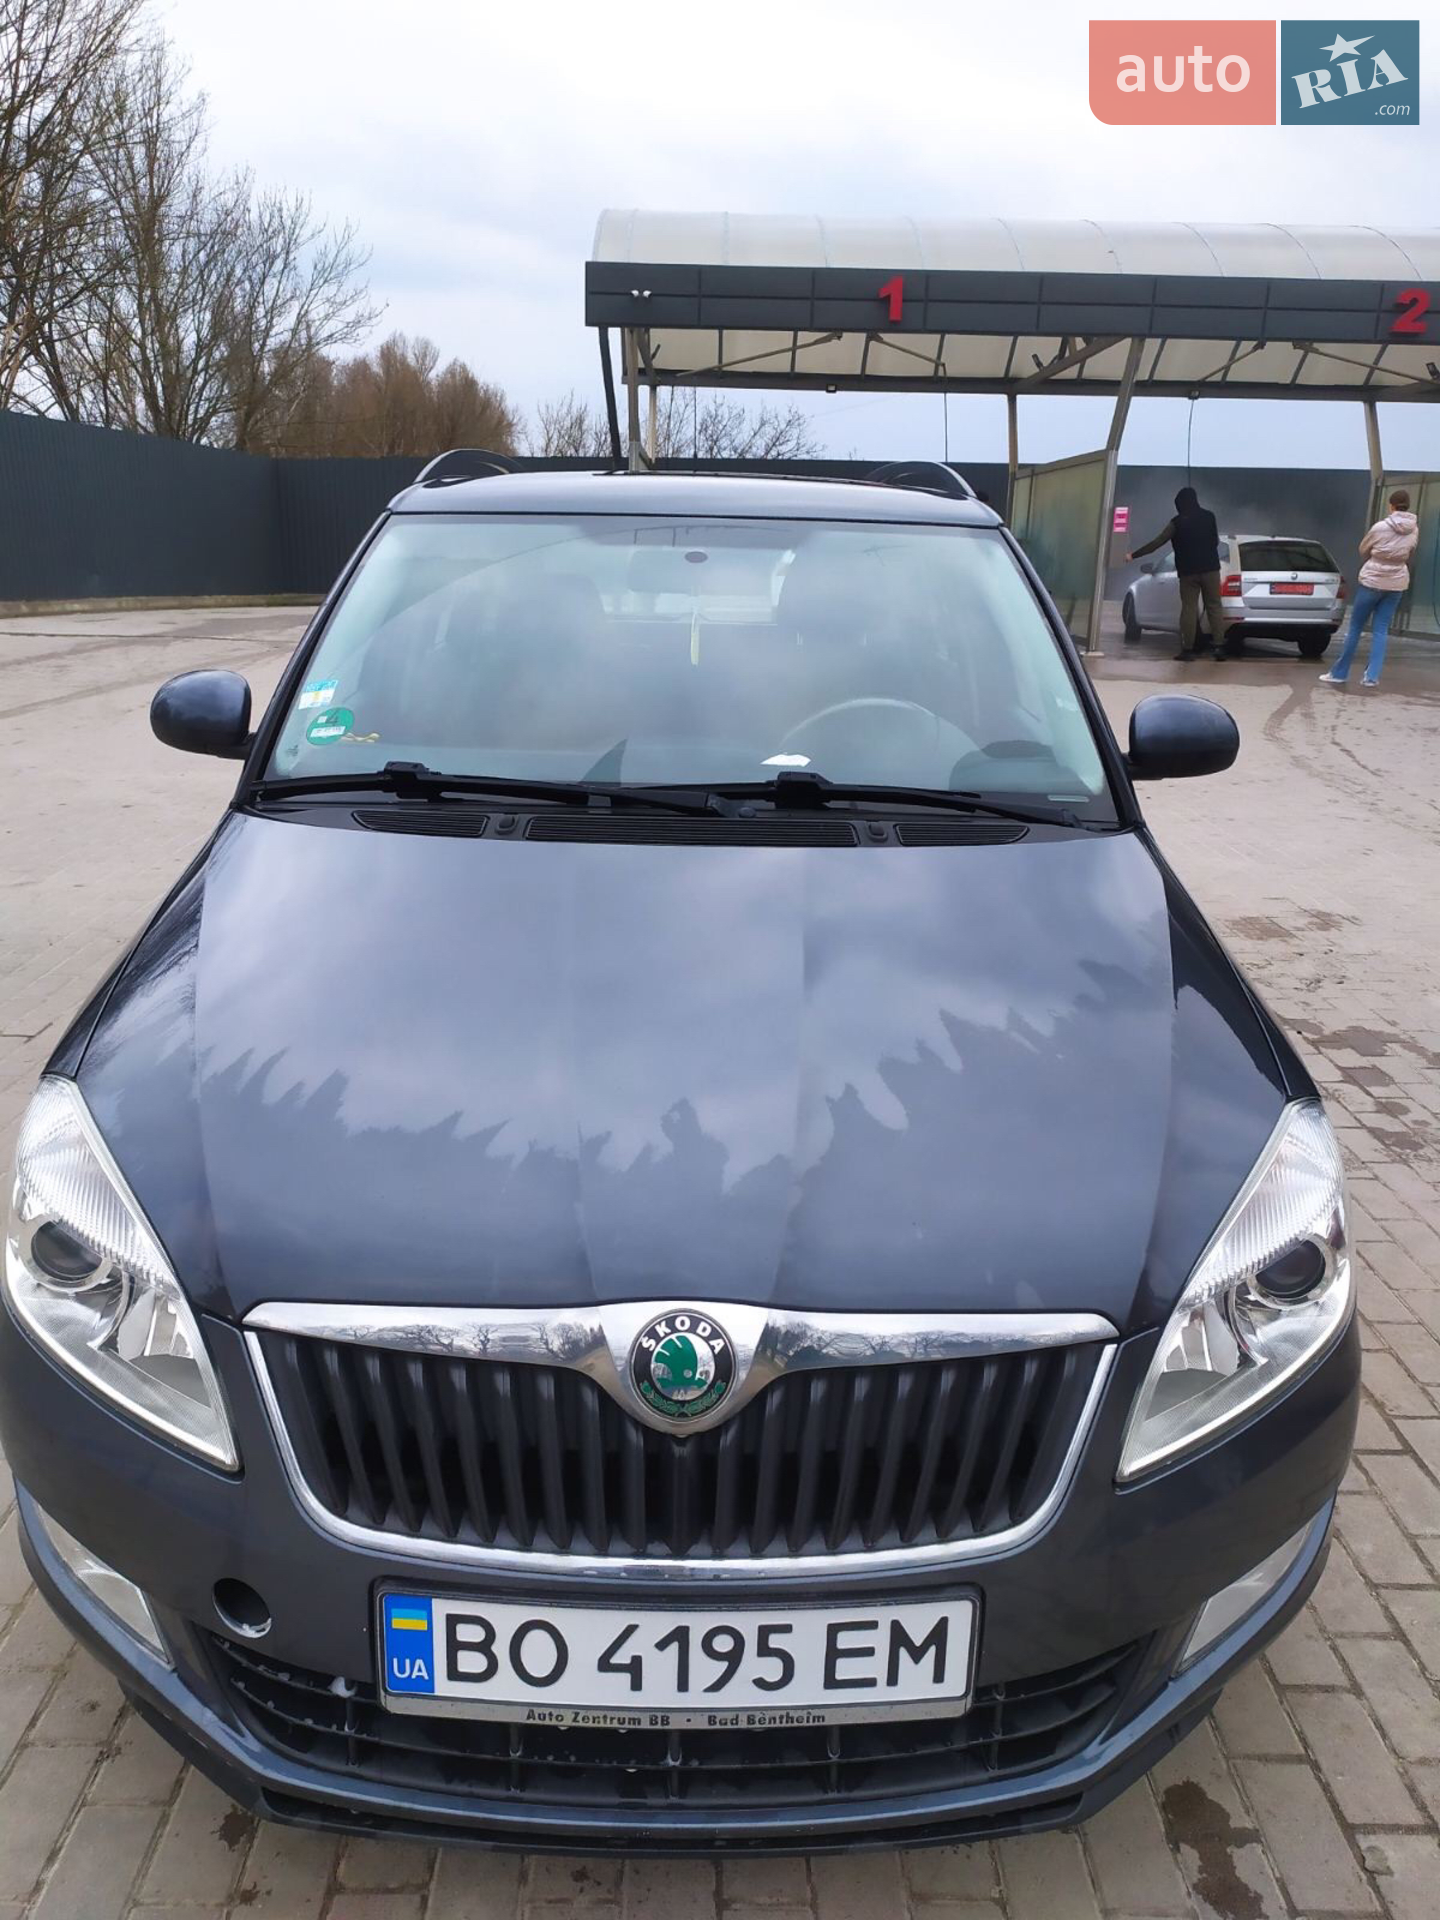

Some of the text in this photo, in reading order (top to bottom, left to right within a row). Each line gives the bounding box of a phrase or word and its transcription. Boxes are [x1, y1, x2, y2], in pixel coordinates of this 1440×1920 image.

[877, 275, 903, 323] 1
[1389, 288, 1430, 334] 2
[392, 1658, 429, 1680] UA
[445, 1612, 949, 1694] BO 4195 EM
[526, 1708, 826, 1727] Auto Zentrum BB Bad Bentheim
